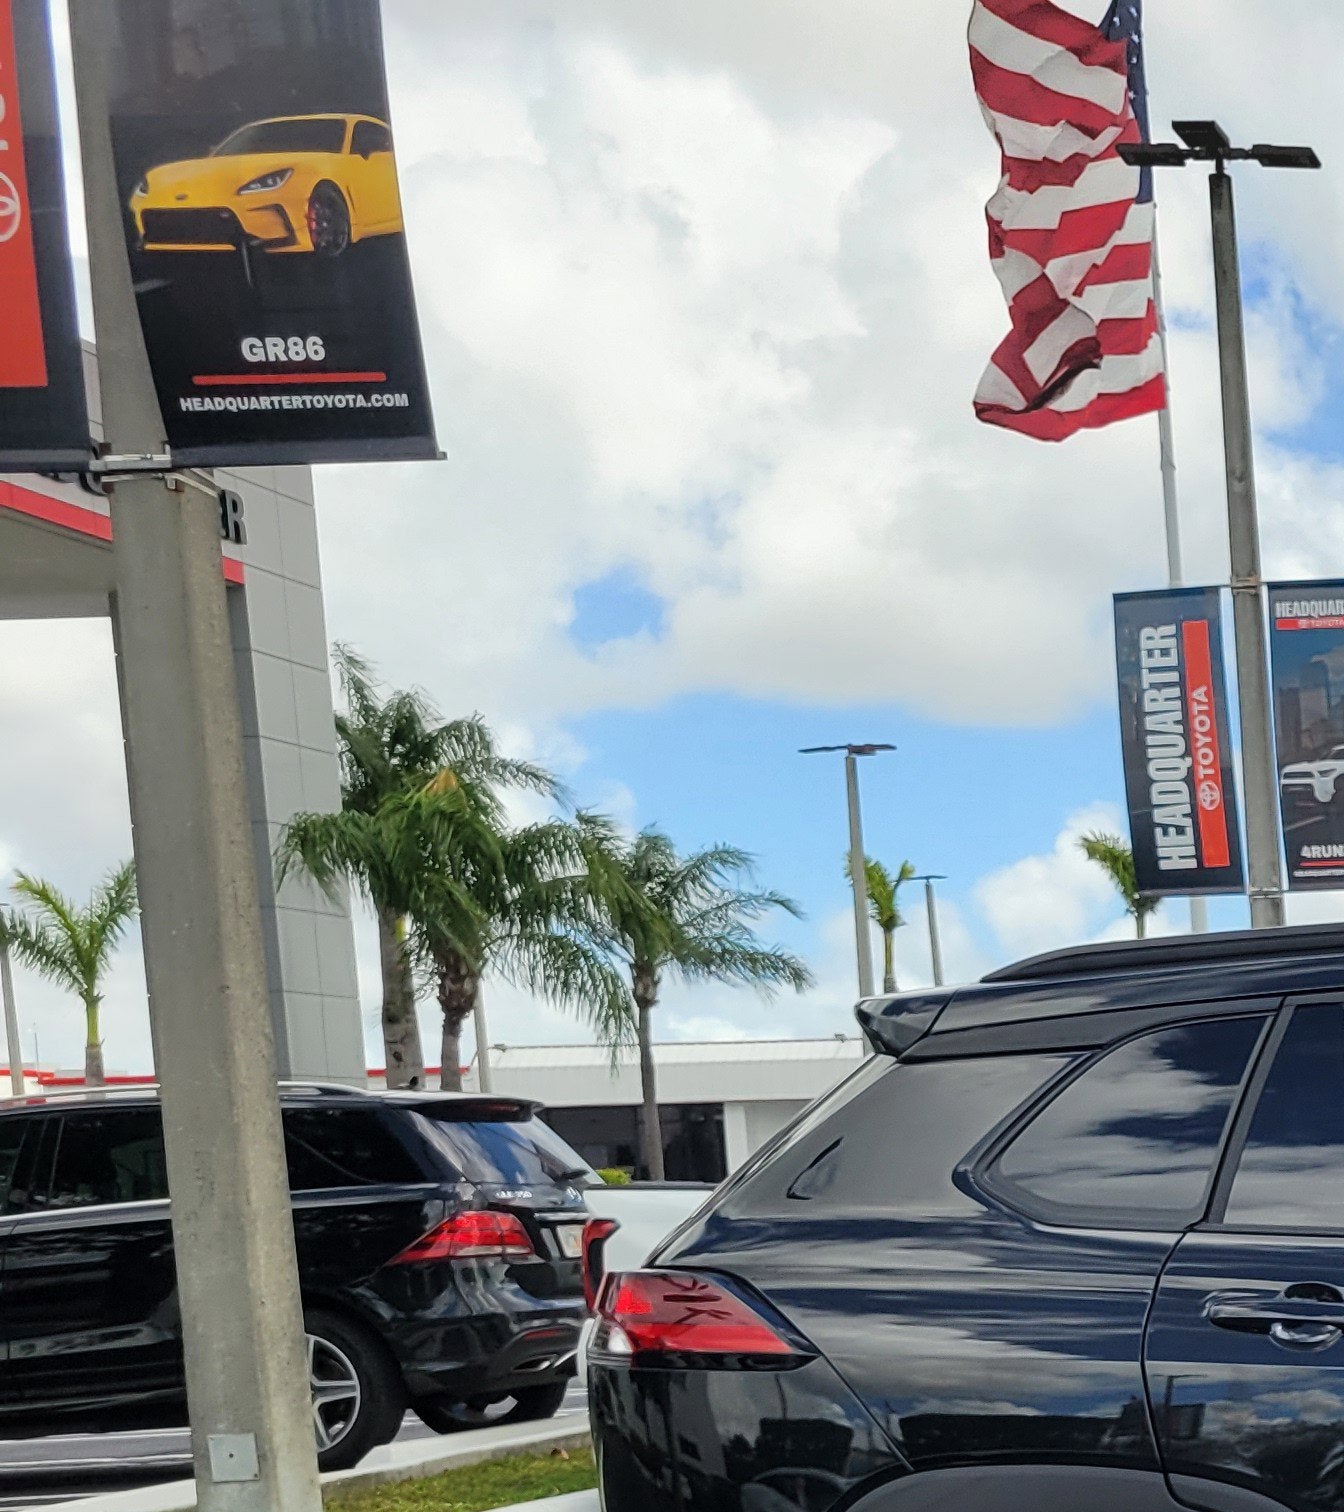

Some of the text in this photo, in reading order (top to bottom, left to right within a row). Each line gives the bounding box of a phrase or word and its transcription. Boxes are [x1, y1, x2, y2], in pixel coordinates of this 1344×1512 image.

[240, 335, 327, 363] GR86
[179, 393, 410, 413] HEADQUARTERTOYOTA.COM
[1139, 623, 1198, 871] HEADQUARTER
[1191, 684, 1221, 778] TOYOTA
